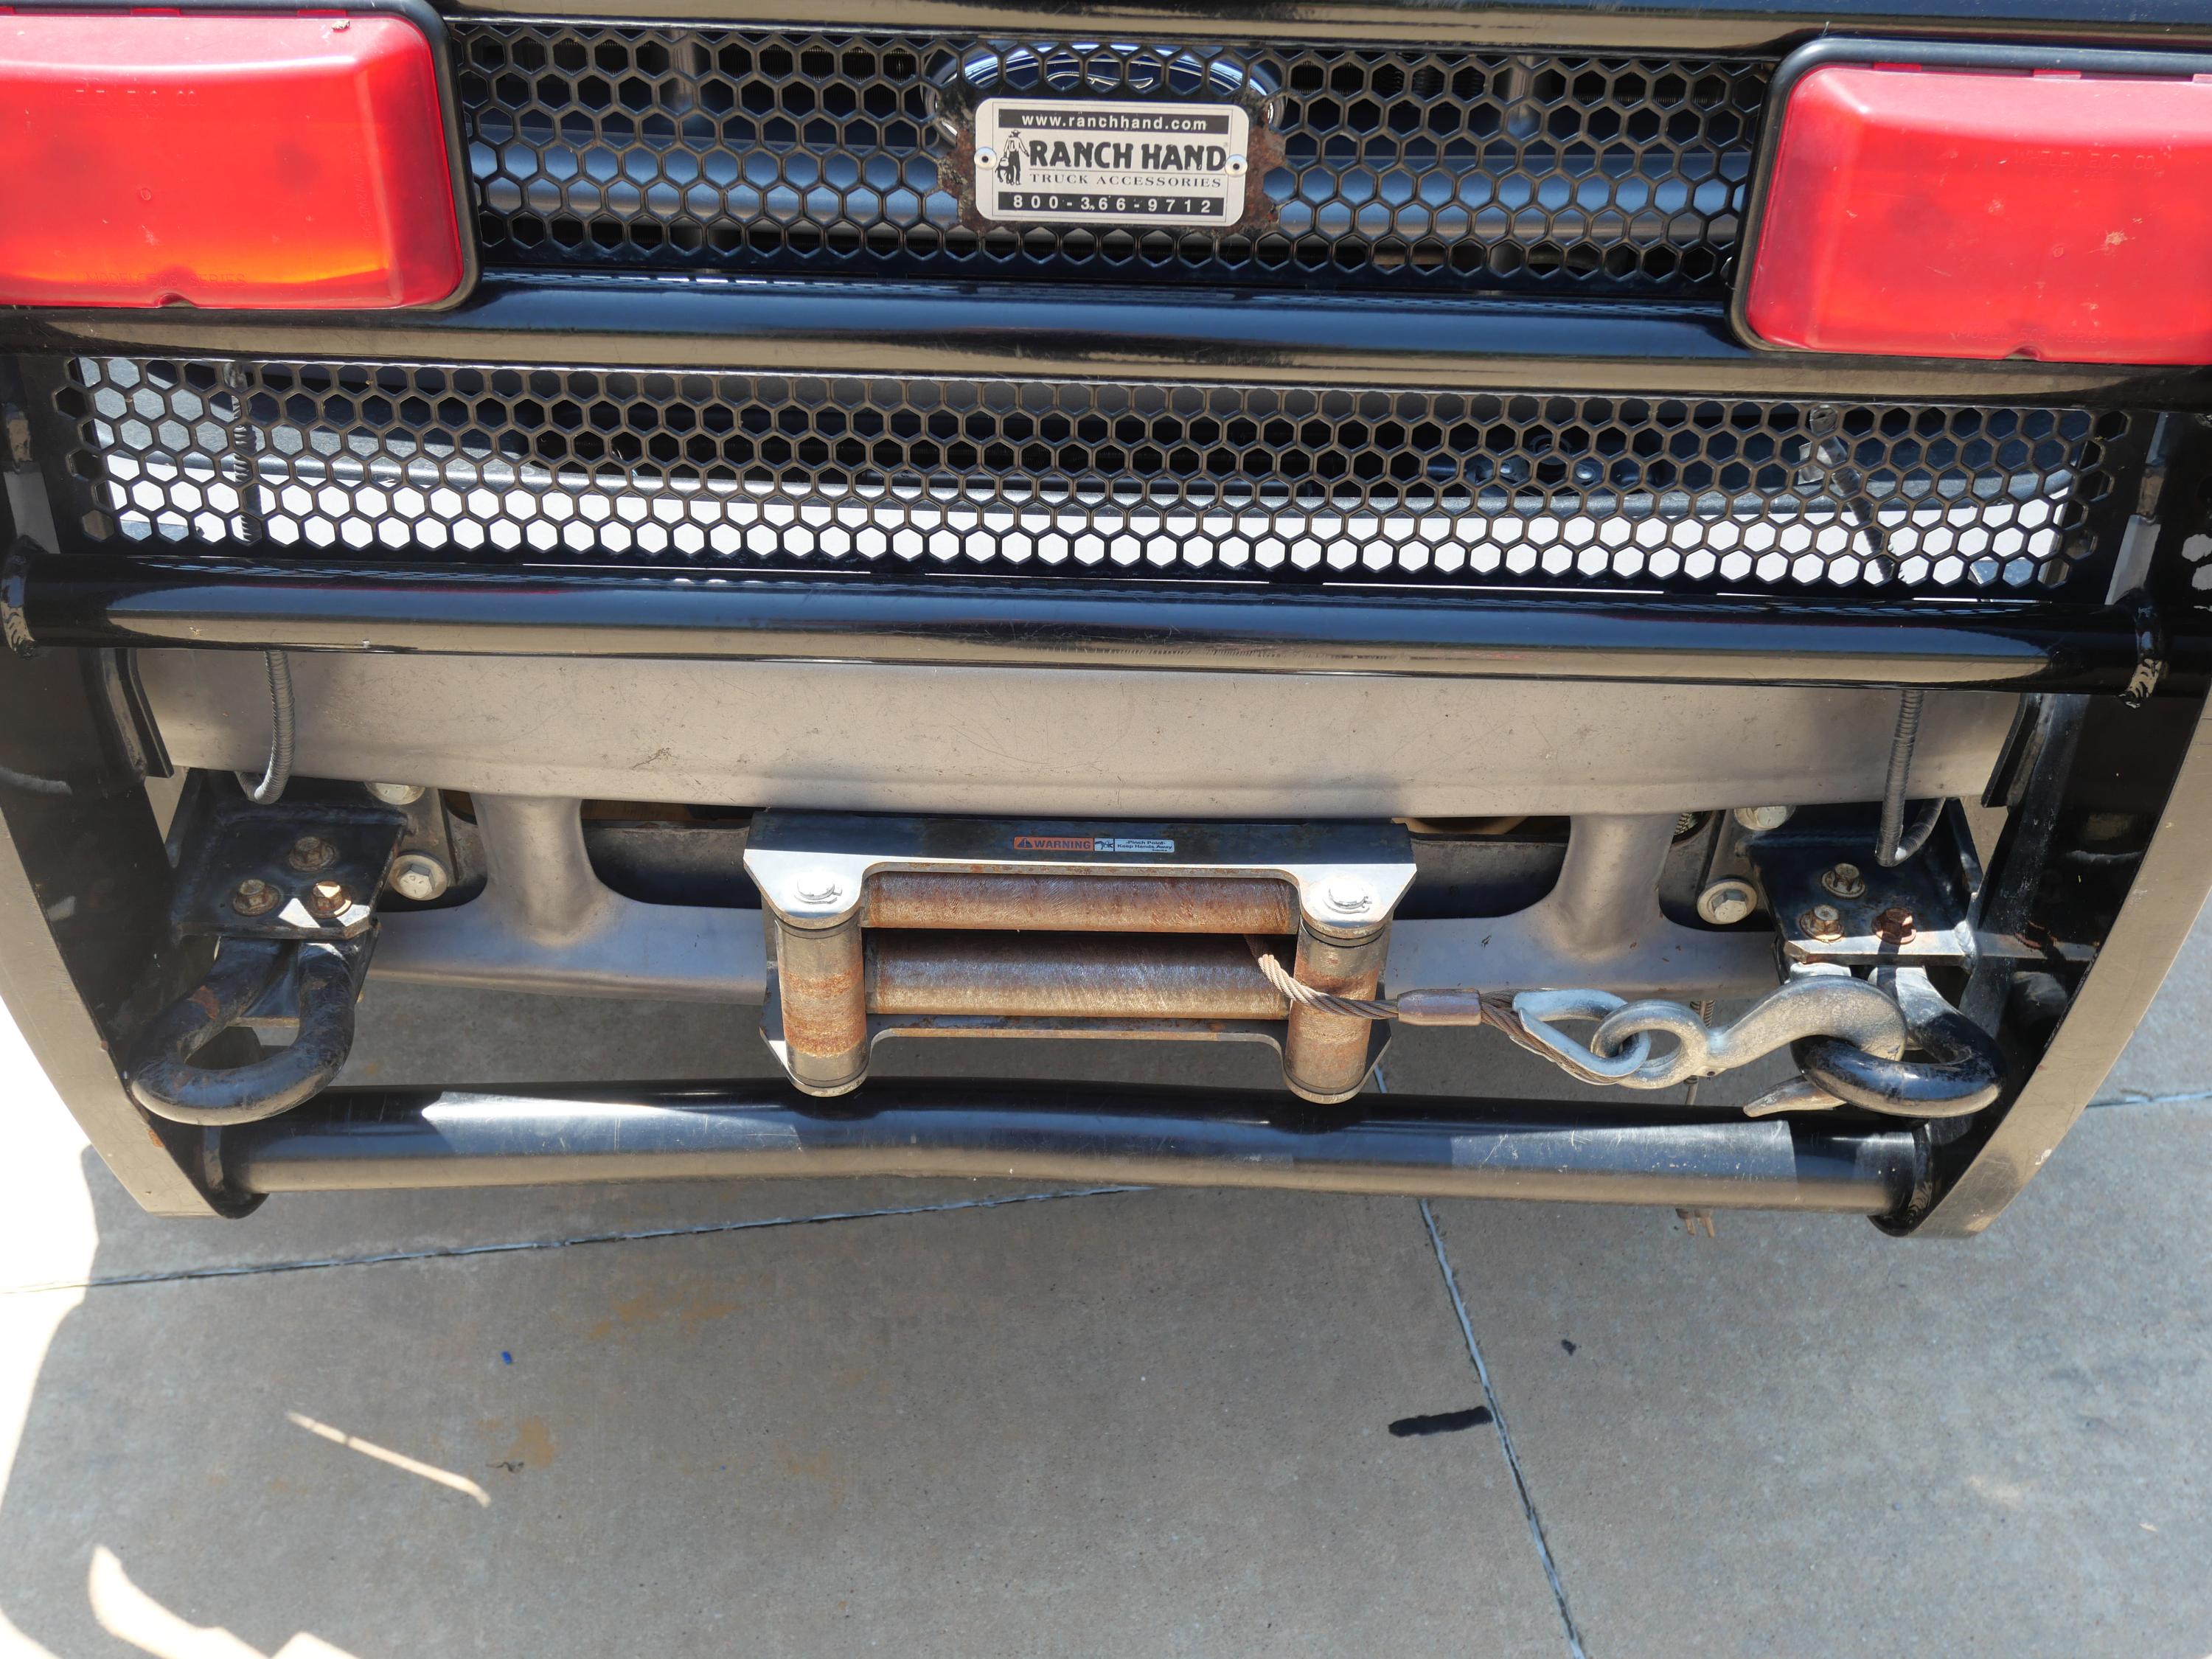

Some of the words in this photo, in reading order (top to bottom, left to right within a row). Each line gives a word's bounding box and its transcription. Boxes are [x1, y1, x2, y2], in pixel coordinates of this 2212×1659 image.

[1021, 112, 1207, 131] www.ranchhand.com
[1029, 139, 1134, 170] RANCH
[1141, 143, 1226, 172] HAND
[1030, 173, 1089, 184] TRUCK
[1097, 175, 1222, 188] ACCESSORIES
[1013, 195, 1211, 214] 800-366-9712
[1034, 840, 1091, 849] WARNING
